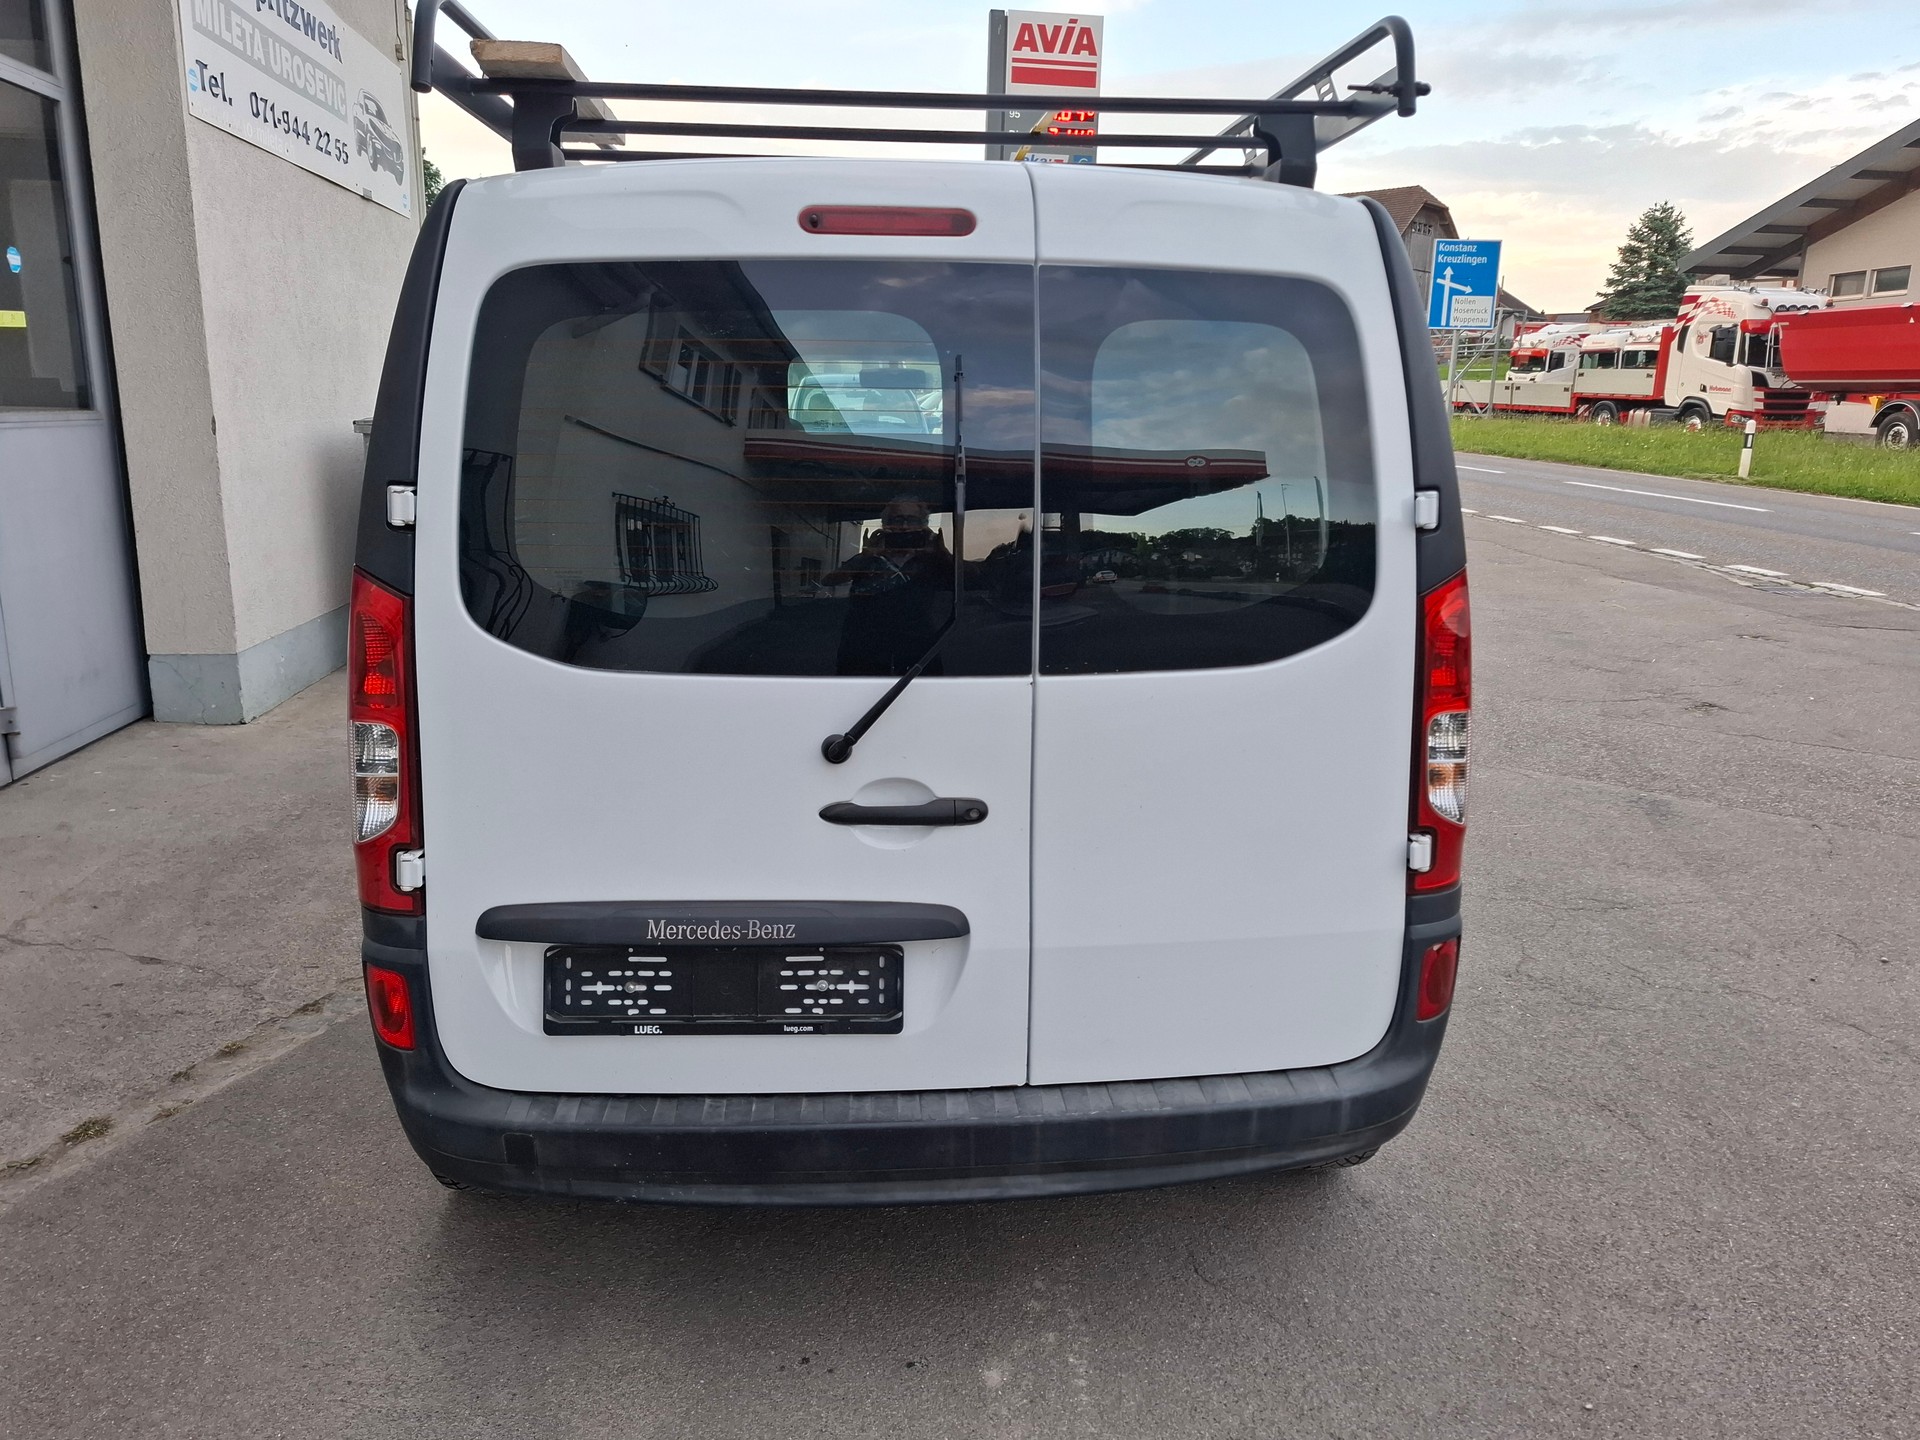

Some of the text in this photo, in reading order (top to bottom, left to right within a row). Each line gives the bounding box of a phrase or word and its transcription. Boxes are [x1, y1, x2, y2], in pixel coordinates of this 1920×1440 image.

[194, 0, 347, 116] MILETA UROSEVIC
[196, 59, 233, 106] Tel.
[250, 92, 311, 146] 071-944
[314, 127, 332, 156] 22
[335, 138, 349, 165] 55
[1439, 242, 1478, 253] Konstanz
[1437, 254, 1488, 266] Kreuzlingen
[1454, 297, 1477, 305] Nollen
[1453, 306, 1489, 315] Hosenruck
[1453, 316, 1489, 326] Wuppenau
[646, 919, 796, 940] Mercedes-Benz
[634, 1025, 663, 1035] LUEG.
[783, 1024, 814, 1034] lueg.com
